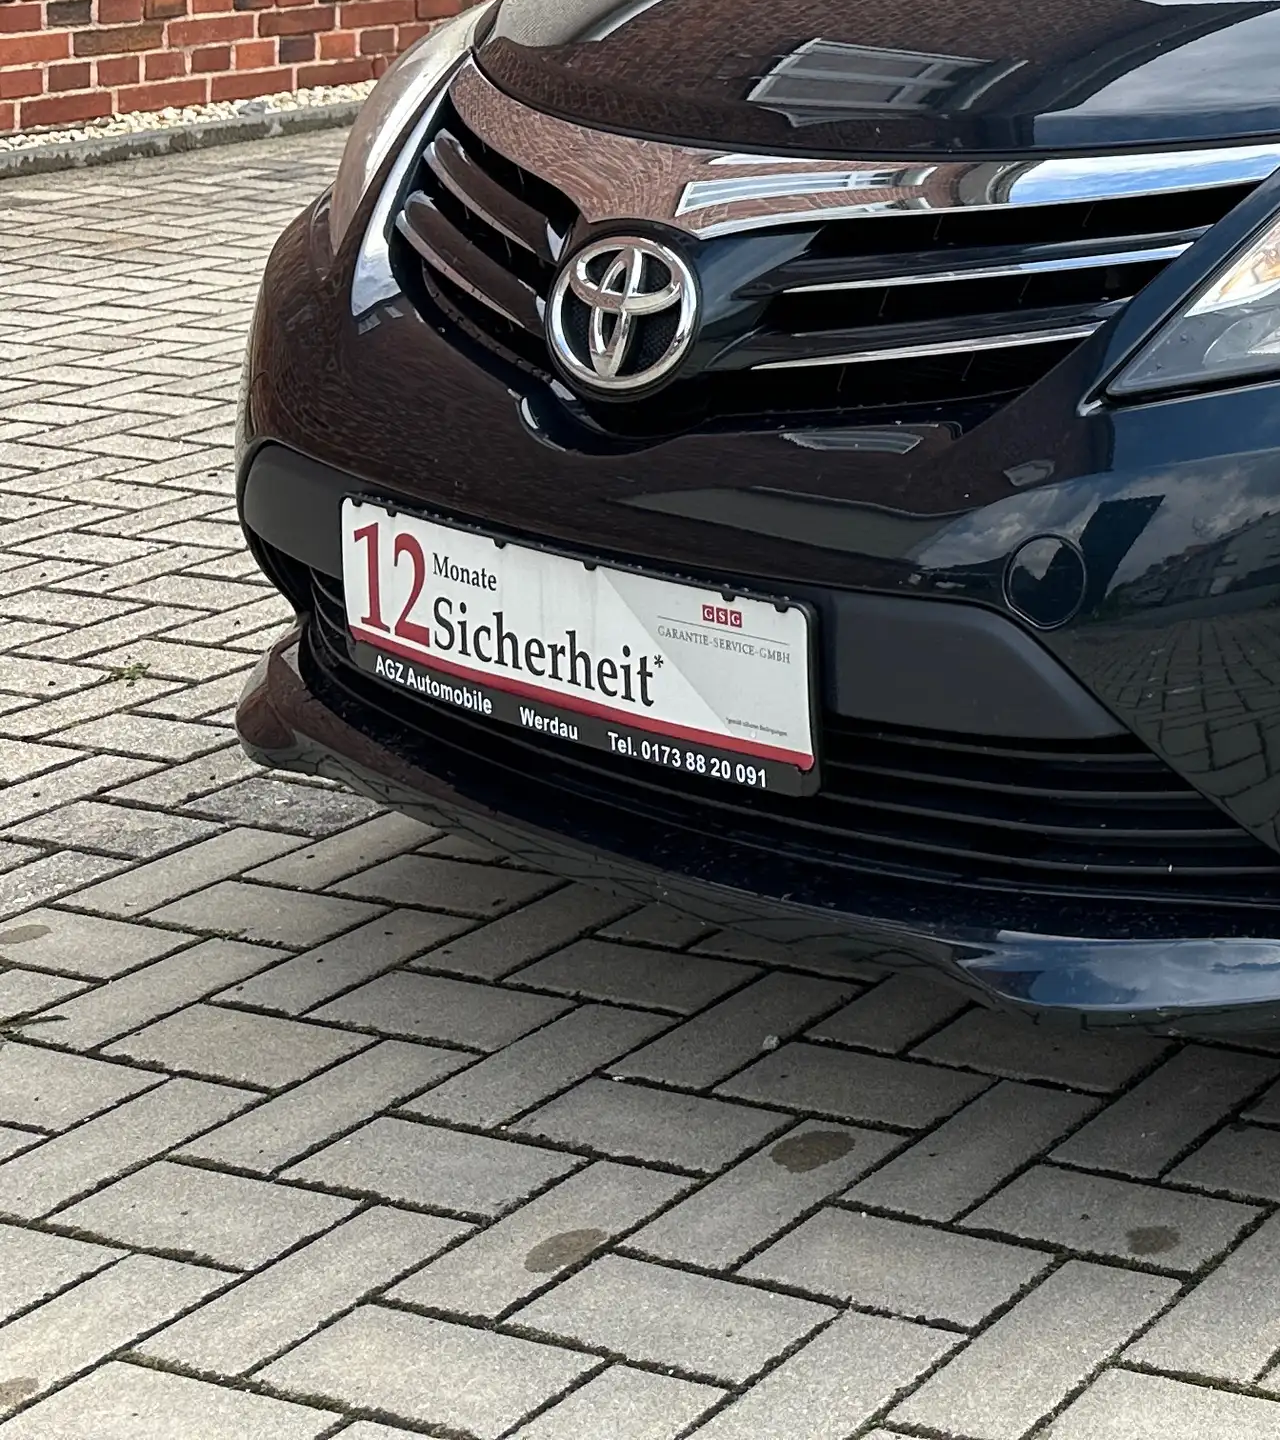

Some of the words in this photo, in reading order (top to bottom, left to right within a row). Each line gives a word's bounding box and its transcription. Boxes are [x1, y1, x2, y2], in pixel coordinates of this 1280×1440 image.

[353, 521, 430, 648] 12
[432, 551, 497, 592] Monate
[703, 606, 742, 628] GSG
[657, 625, 791, 664] GARANTIE-SERVICE-GMBH
[375, 655, 405, 684] AGZ
[406, 667, 493, 715] Automobile
[519, 706, 579, 741] Werdau
[607, 731, 638, 757] Tel.
[641, 739, 682, 768] 0173
[685, 751, 706, 774] 88
[710, 757, 731, 780] 20
[735, 764, 767, 789] 091
